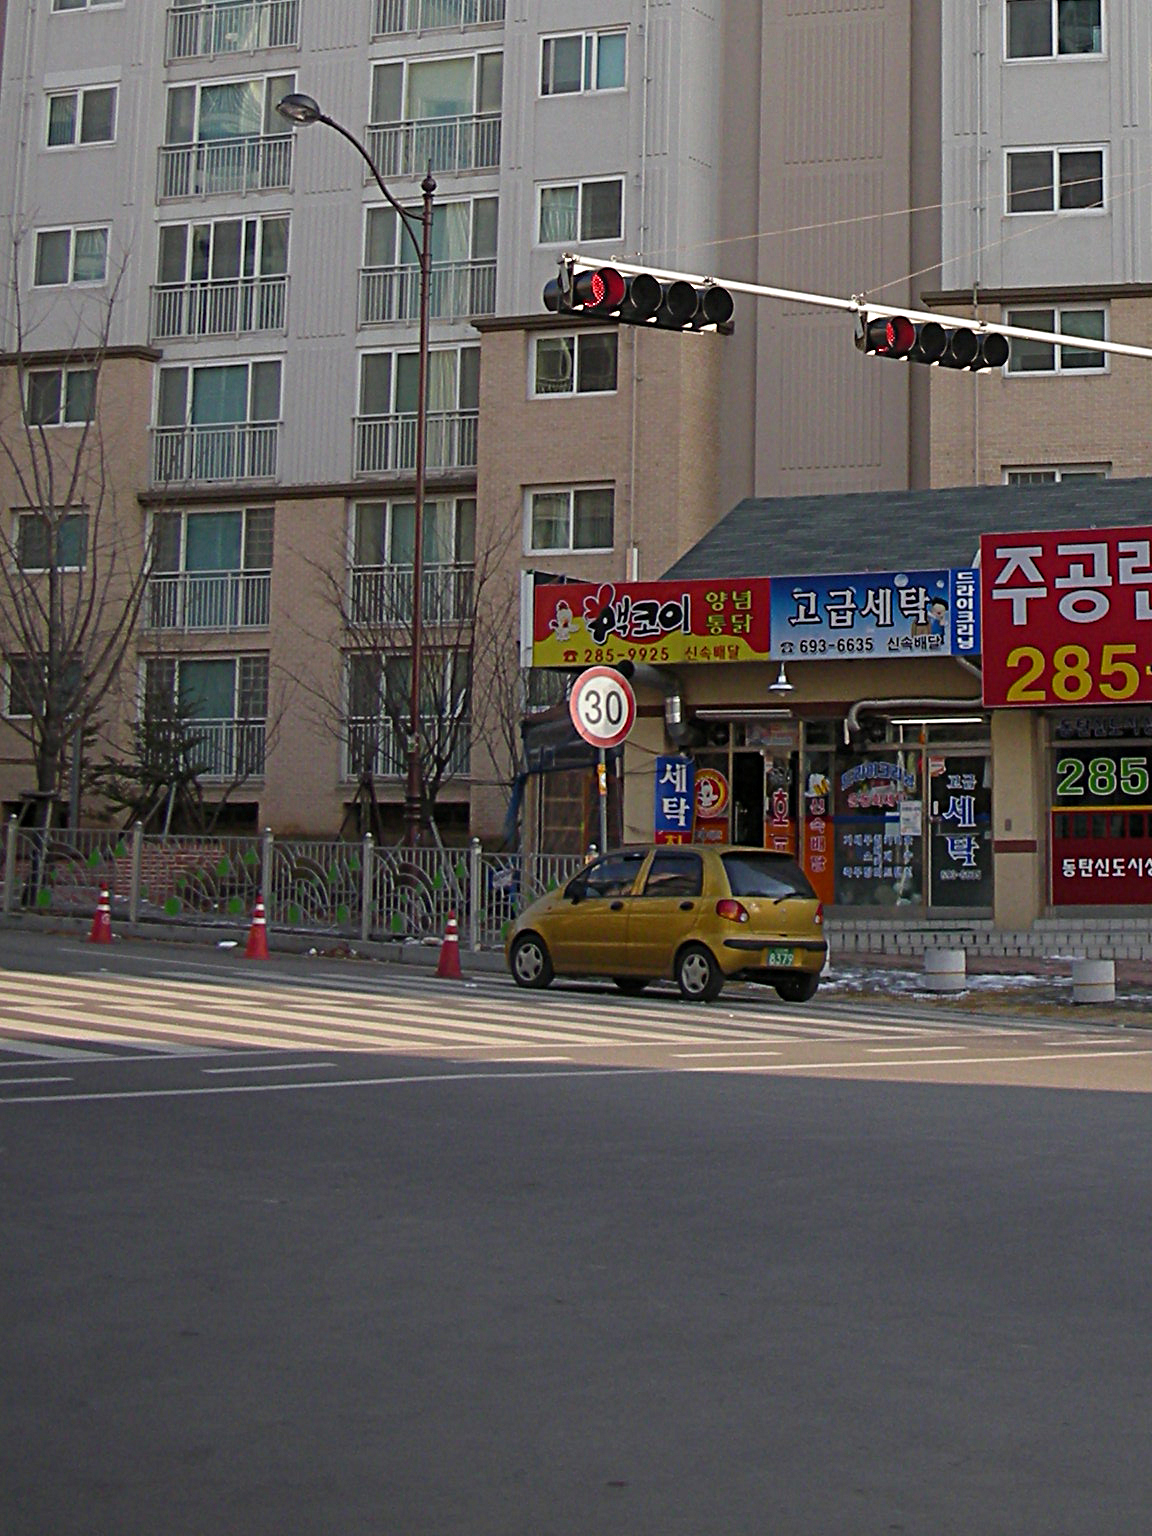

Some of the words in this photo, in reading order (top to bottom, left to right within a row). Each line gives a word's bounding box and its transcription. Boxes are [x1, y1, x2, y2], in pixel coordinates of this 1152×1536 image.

[705, 590, 752, 612] 양념
[789, 586, 931, 629] 고급세탁
[955, 571, 976, 650] 드라이크리닝
[706, 614, 753, 635] 통닭
[584, 647, 670, 663] 285-9925
[800, 637, 874, 653] 693-6635
[887, 634, 944, 652] 신속배달
[585, 690, 623, 726] 30
[659, 763, 691, 827] 세탁
[942, 795, 981, 866] 세탁
